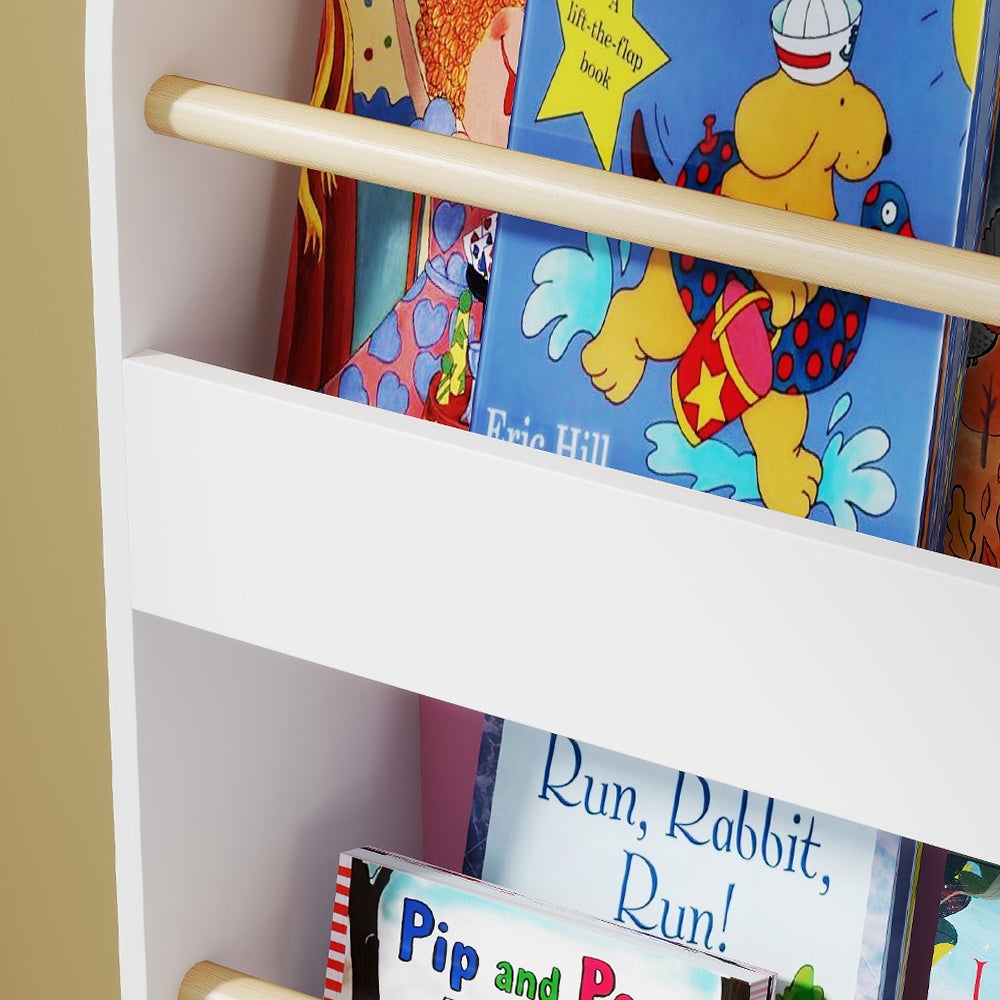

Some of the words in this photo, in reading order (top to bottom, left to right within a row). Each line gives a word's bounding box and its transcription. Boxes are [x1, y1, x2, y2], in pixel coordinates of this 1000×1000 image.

[566, 0, 643, 73] lift-the-flap
[579, 50, 611, 90] book
[486, 407, 546, 451] Eric
[556, 423, 611, 467] Hill
[538, 733, 647, 841] Run,
[665, 771, 831, 896] Rabbit,
[613, 849, 735, 953] Run!
[398, 897, 480, 991] Pip
[494, 961, 560, 1000] and
